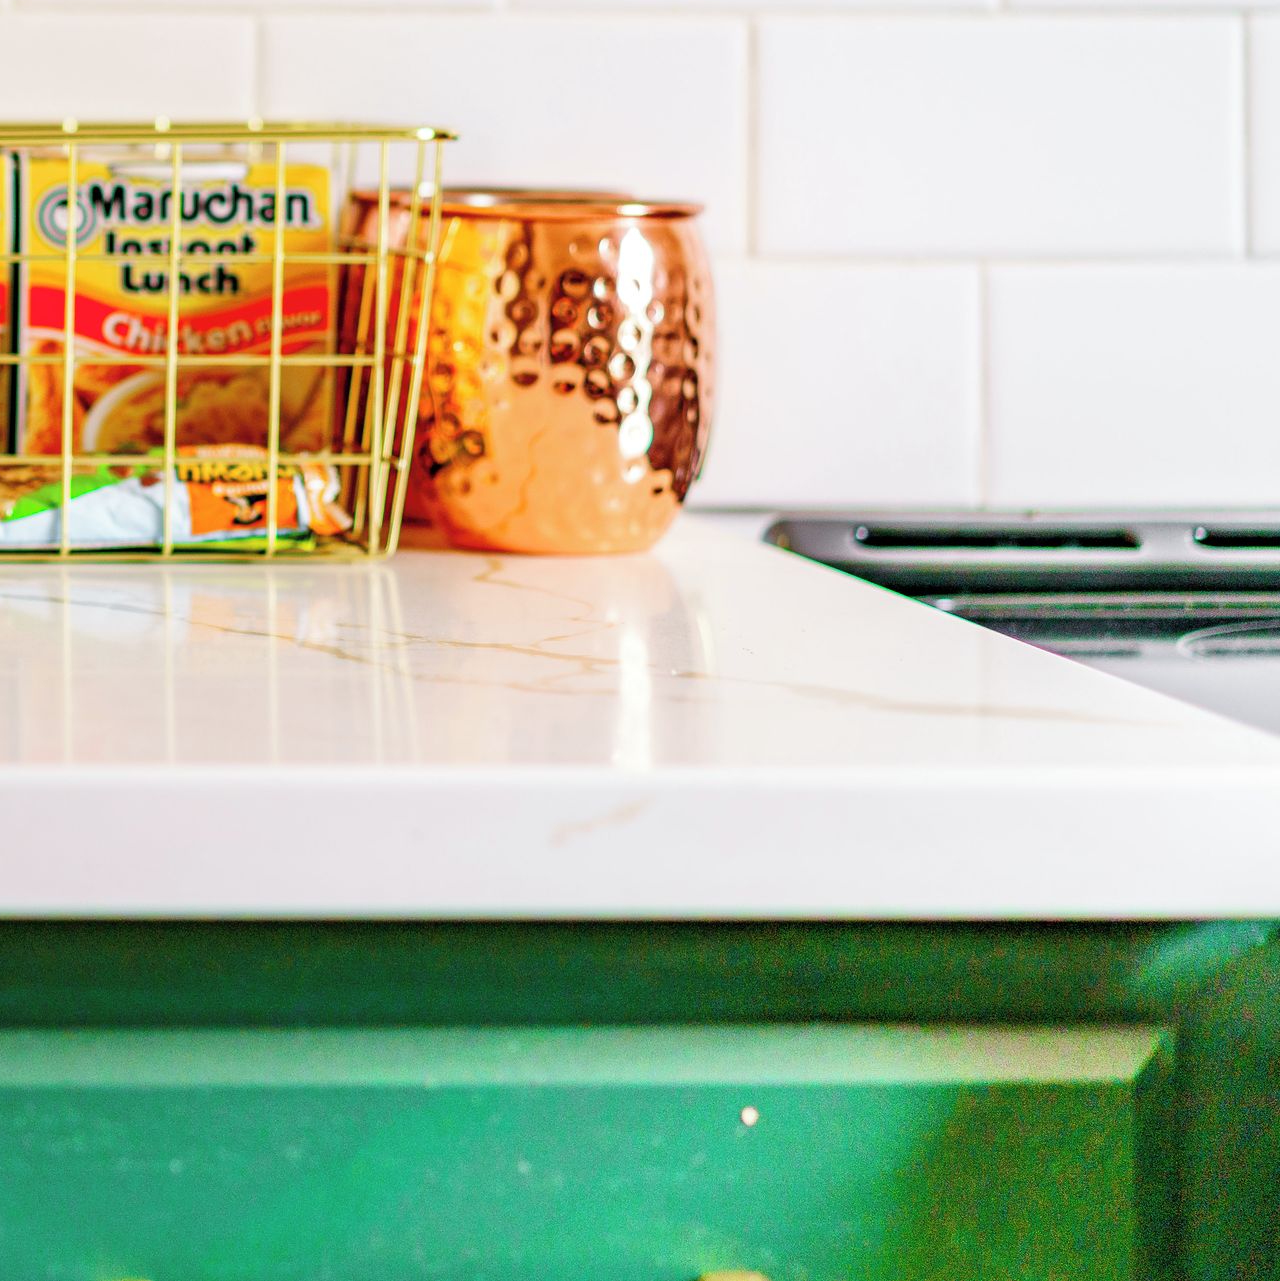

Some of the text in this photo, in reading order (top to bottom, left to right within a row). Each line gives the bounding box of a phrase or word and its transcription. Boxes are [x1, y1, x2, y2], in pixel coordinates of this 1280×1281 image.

[89, 184, 310, 224] Maruchan
[105, 230, 255, 256] Insant
[122, 263, 239, 293] Lunch
[101, 311, 253, 354] Chiken
